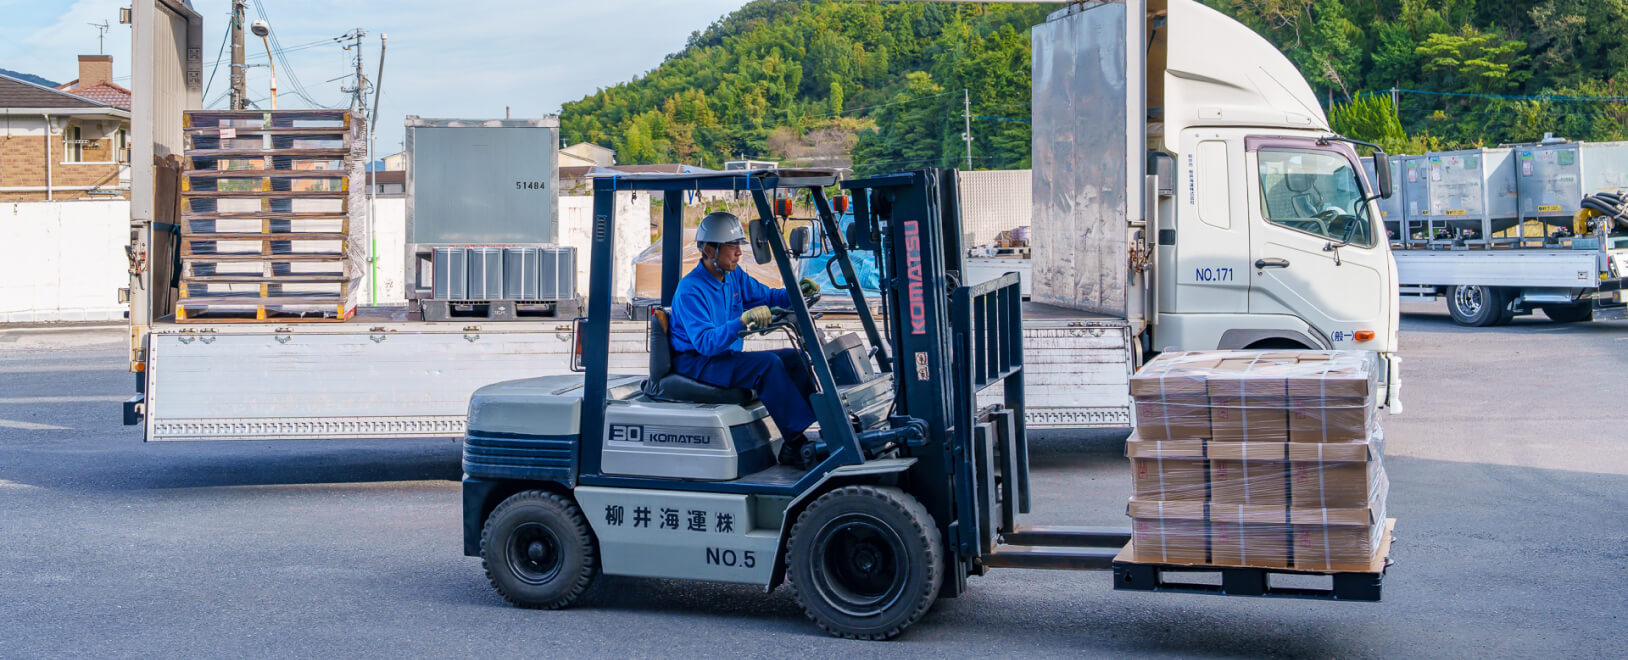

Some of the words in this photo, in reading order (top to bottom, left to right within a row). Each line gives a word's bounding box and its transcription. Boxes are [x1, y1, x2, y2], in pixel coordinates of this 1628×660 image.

[516, 181, 545, 190] 51484
[904, 220, 926, 335] KOMATSU
[1196, 267, 1233, 281] NO.171
[613, 425, 641, 441] 30
[649, 433, 711, 444] KOMATSU
[706, 547, 756, 569] NO.5
